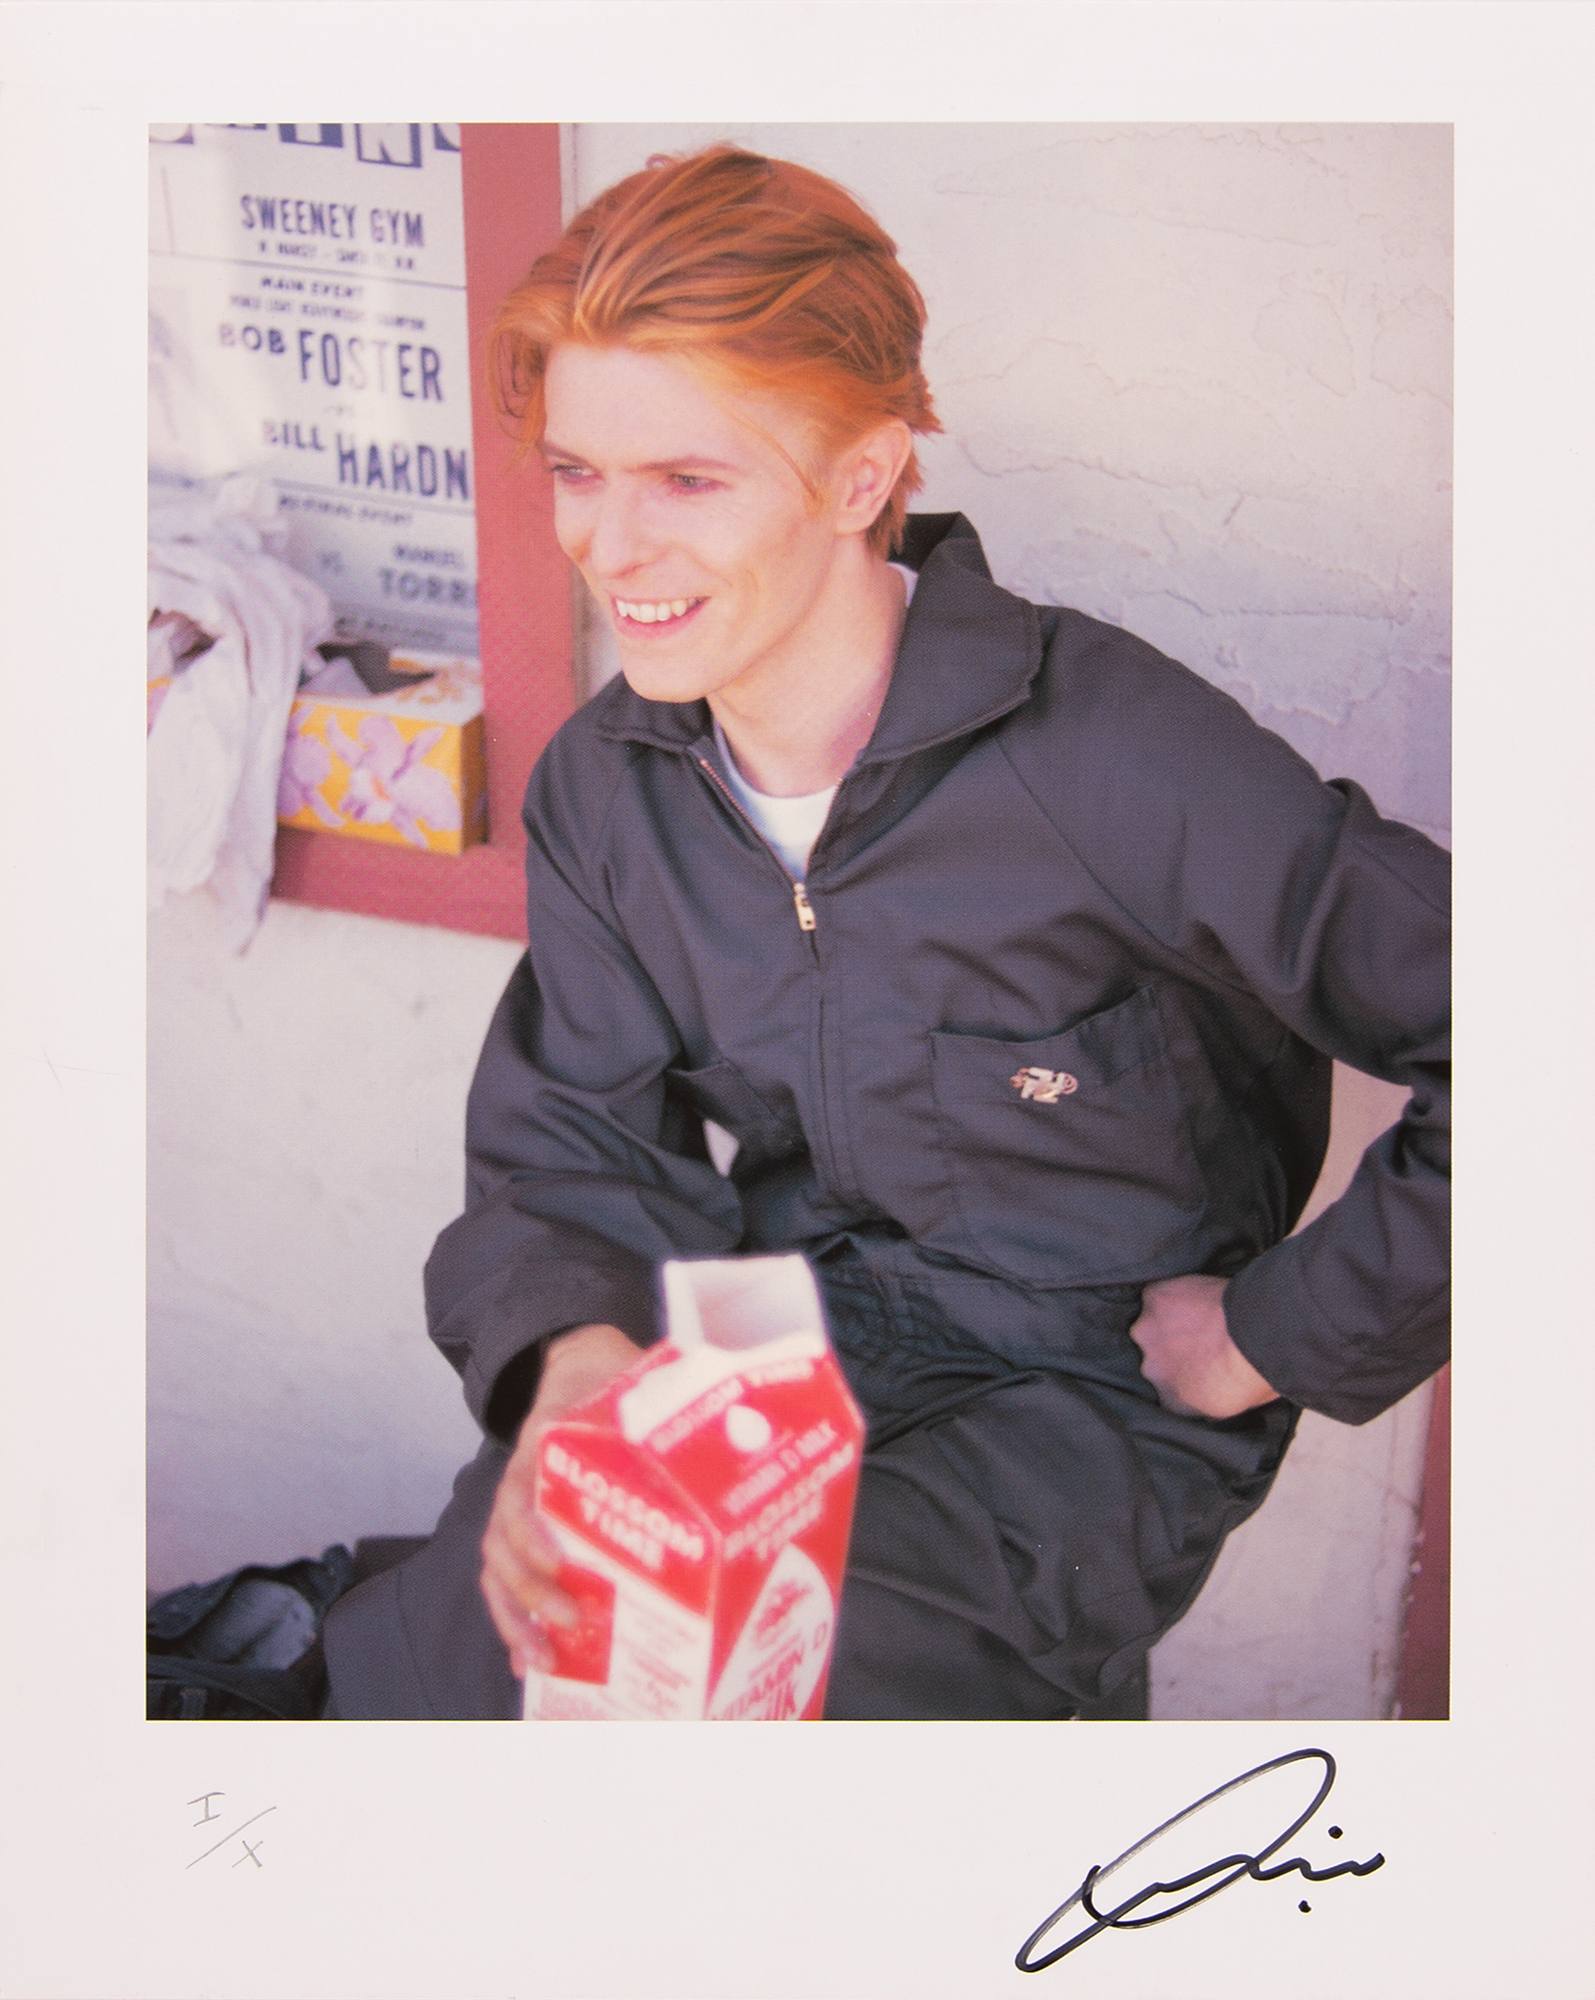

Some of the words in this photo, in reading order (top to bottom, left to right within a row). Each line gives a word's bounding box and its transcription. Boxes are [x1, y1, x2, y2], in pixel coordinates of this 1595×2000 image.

[240, 194, 357, 241] SWEENEY
[369, 206, 426, 249] GYM
[218, 321, 286, 355] BOB
[297, 328, 443, 402] FOSTER
[262, 417, 326, 452] BILL
[378, 565, 478, 609] TORR
[544, 1441, 705, 1563] BLOSSOM
[579, 1495, 665, 1571] TIME
[723, 1440, 856, 1562] BLOSSOM
